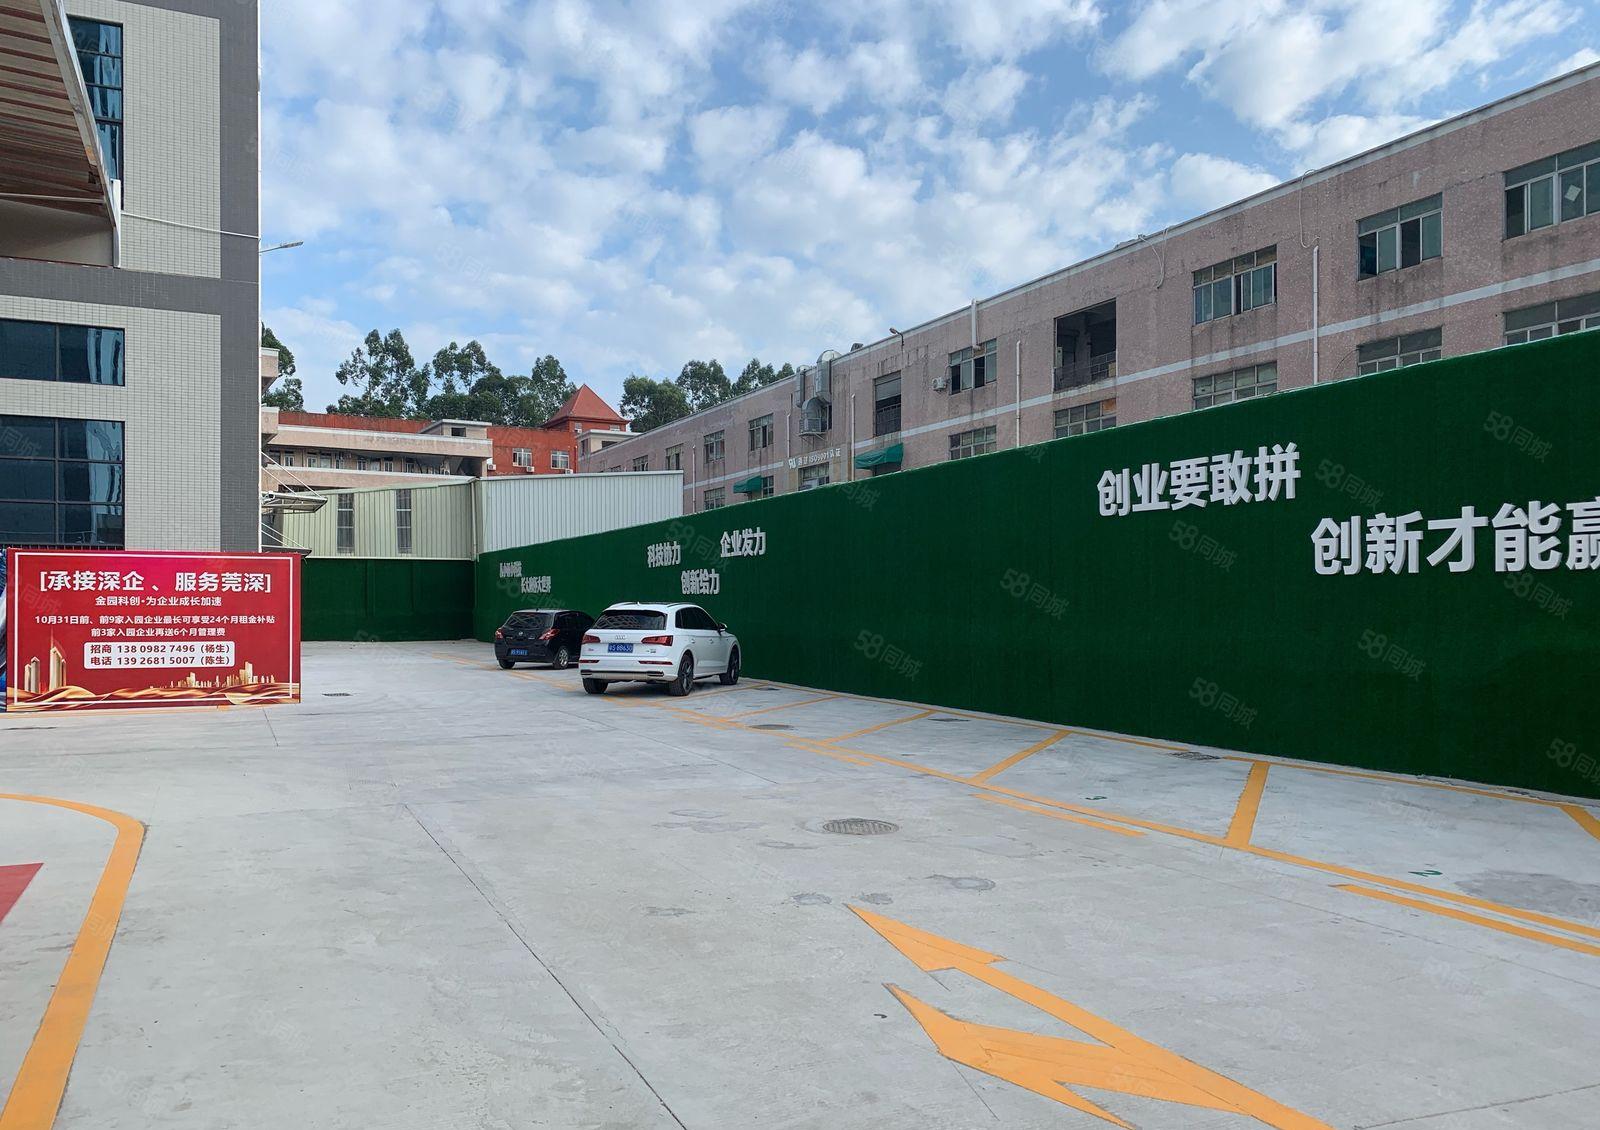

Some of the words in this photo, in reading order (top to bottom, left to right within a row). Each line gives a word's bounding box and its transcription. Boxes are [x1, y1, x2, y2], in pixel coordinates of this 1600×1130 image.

[1097, 442, 1301, 517] 创业要敢拼
[647, 540, 681, 568] 科技协力
[720, 527, 766, 558] 企业发力
[681, 568, 720, 595] 创新给力
[90, 644, 112, 654] 招商
[117, 645, 137, 653] 138
[140, 644, 167, 653] 0982
[169, 644, 196, 653] 7496
[90, 656, 112, 666] 电话
[117, 657, 137, 665] 139
[140, 656, 166, 665] 2681
[169, 656, 195, 665] 5007
